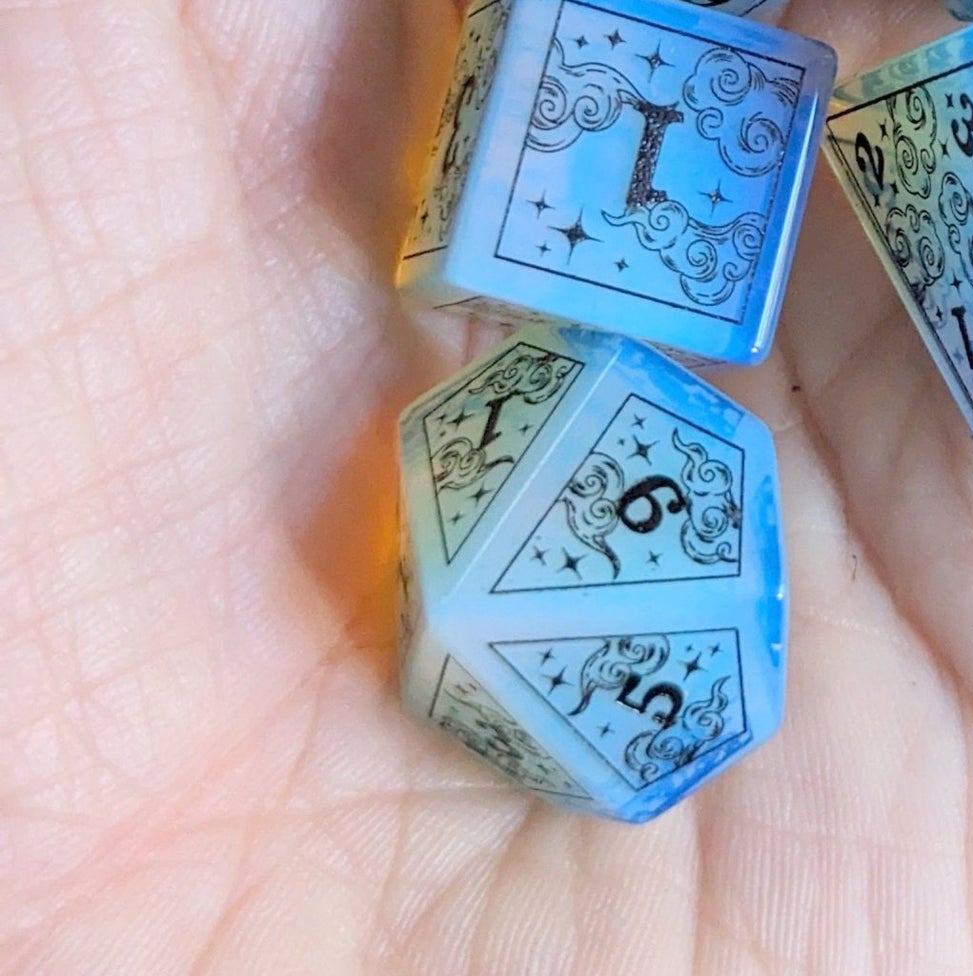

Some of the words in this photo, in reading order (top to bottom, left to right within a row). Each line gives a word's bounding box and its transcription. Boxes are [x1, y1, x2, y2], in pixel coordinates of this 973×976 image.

[625, 100, 685, 212] 1
[854, 130, 885, 192] 2
[615, 672, 685, 729] 5
